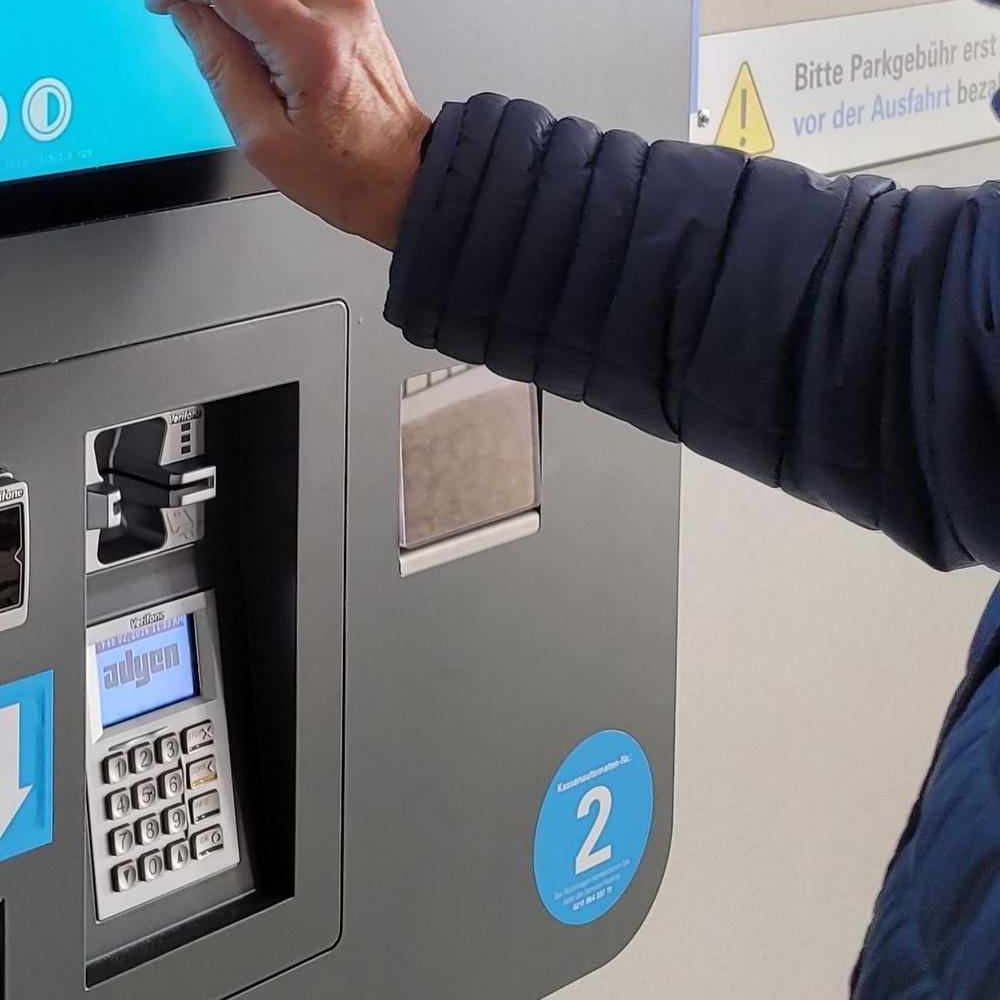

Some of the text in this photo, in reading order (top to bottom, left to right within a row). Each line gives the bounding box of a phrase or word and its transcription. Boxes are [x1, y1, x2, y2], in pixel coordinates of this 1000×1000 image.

[794, 34, 997, 92] Bitte Parkgebühr erst
[793, 70, 1000, 137] vor der Ausfahrt beza
[103, 643, 180, 690] adyen
[114, 740, 176, 774] 1 2 3
[117, 796, 126, 813] 4
[169, 775, 178, 793] 6
[119, 810, 182, 849] 7 8 9
[574, 785, 612, 875] 2
